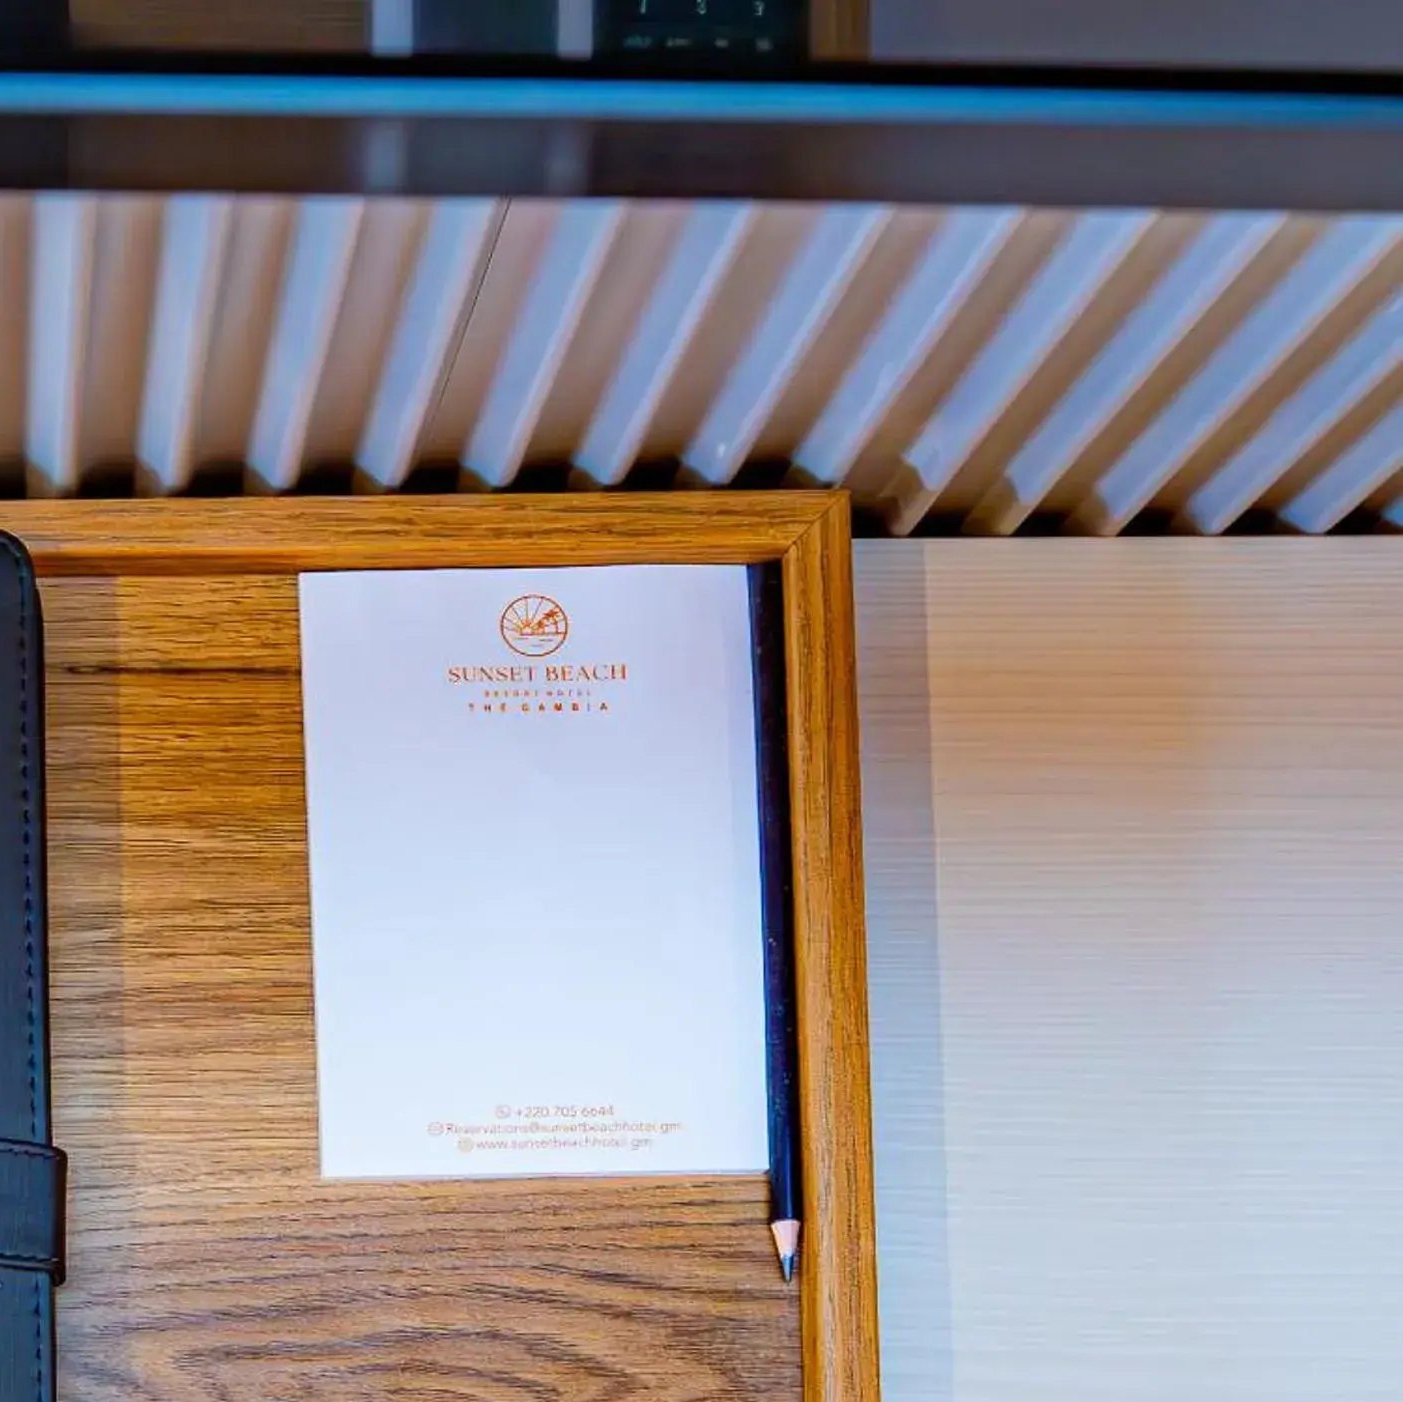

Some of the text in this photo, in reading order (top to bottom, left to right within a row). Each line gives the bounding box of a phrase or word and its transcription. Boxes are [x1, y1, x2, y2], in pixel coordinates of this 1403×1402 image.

[448, 664, 628, 683] SUNSET BEACH
[468, 702, 609, 713] THE GAMBIA
[554, 1105, 577, 1117] 705
